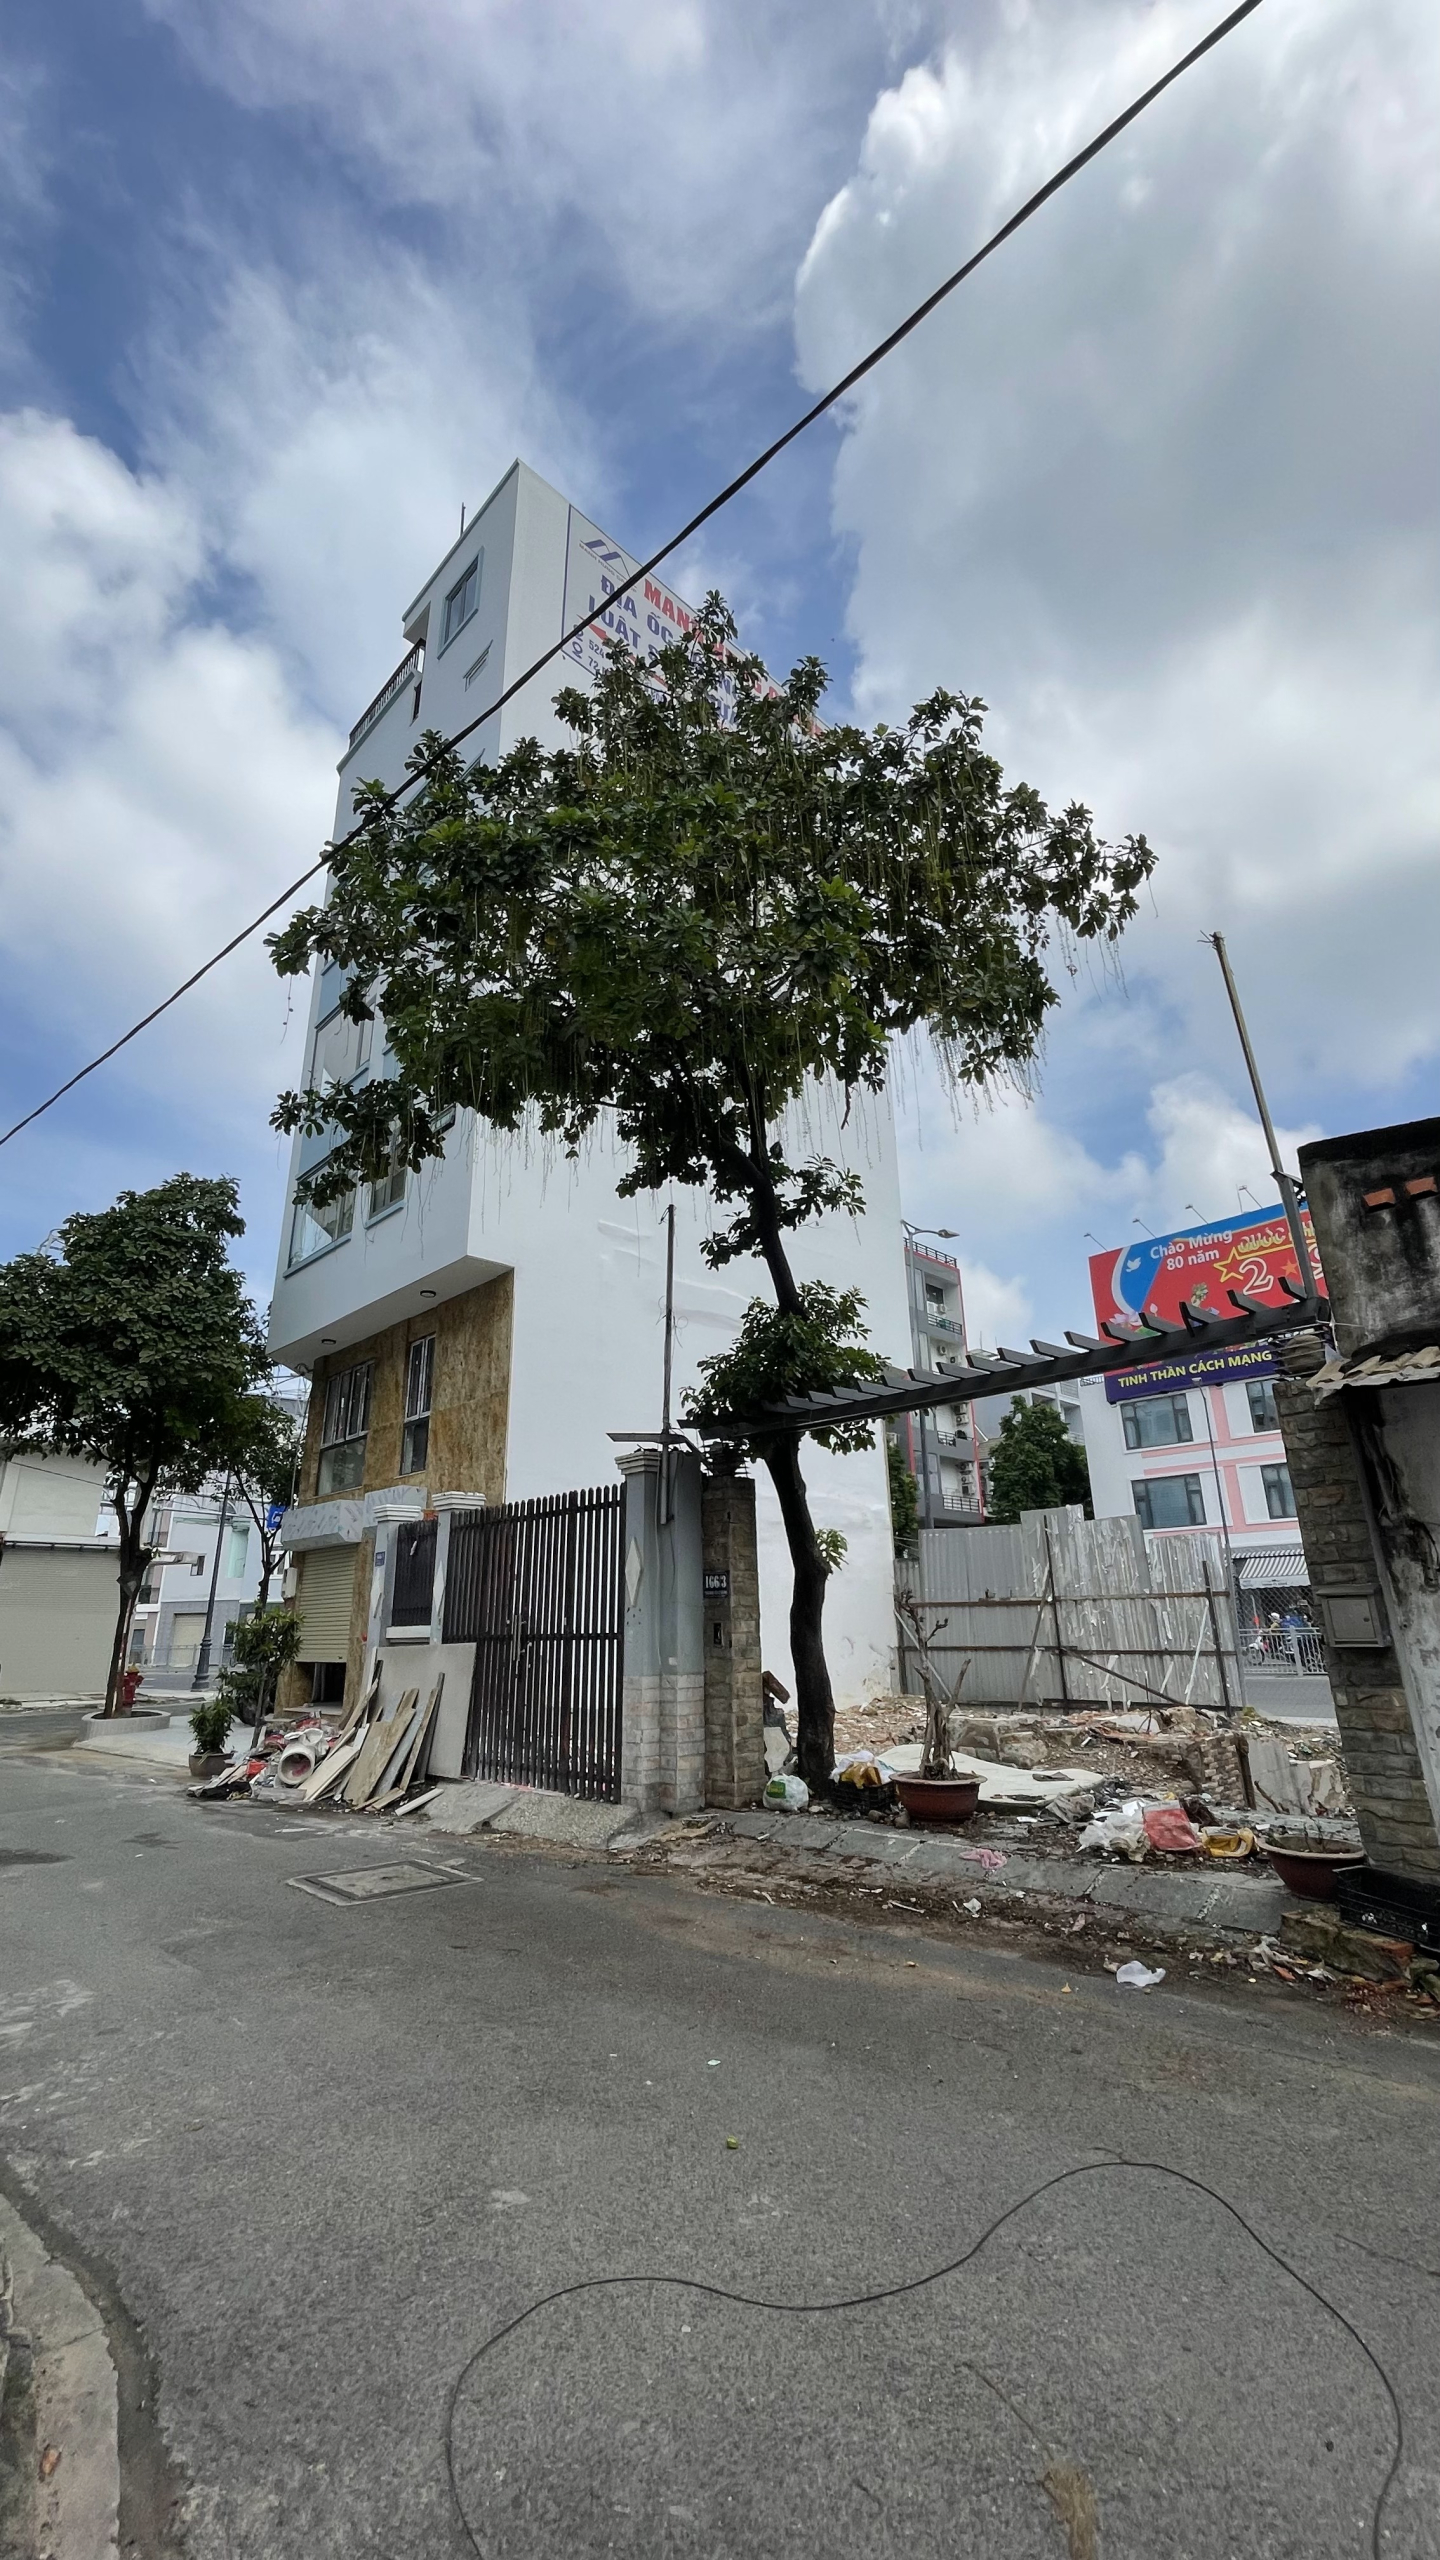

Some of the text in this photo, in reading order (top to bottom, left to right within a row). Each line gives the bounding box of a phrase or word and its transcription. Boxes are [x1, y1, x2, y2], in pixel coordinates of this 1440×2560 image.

[1150, 1229, 1233, 1260] Chào Mừng
[1166, 1249, 1220, 1271] 80 năm
[1238, 1256, 1275, 1296] 2
[1117, 1350, 1273, 1388] TINH THẦN CÁCH MẠNG
